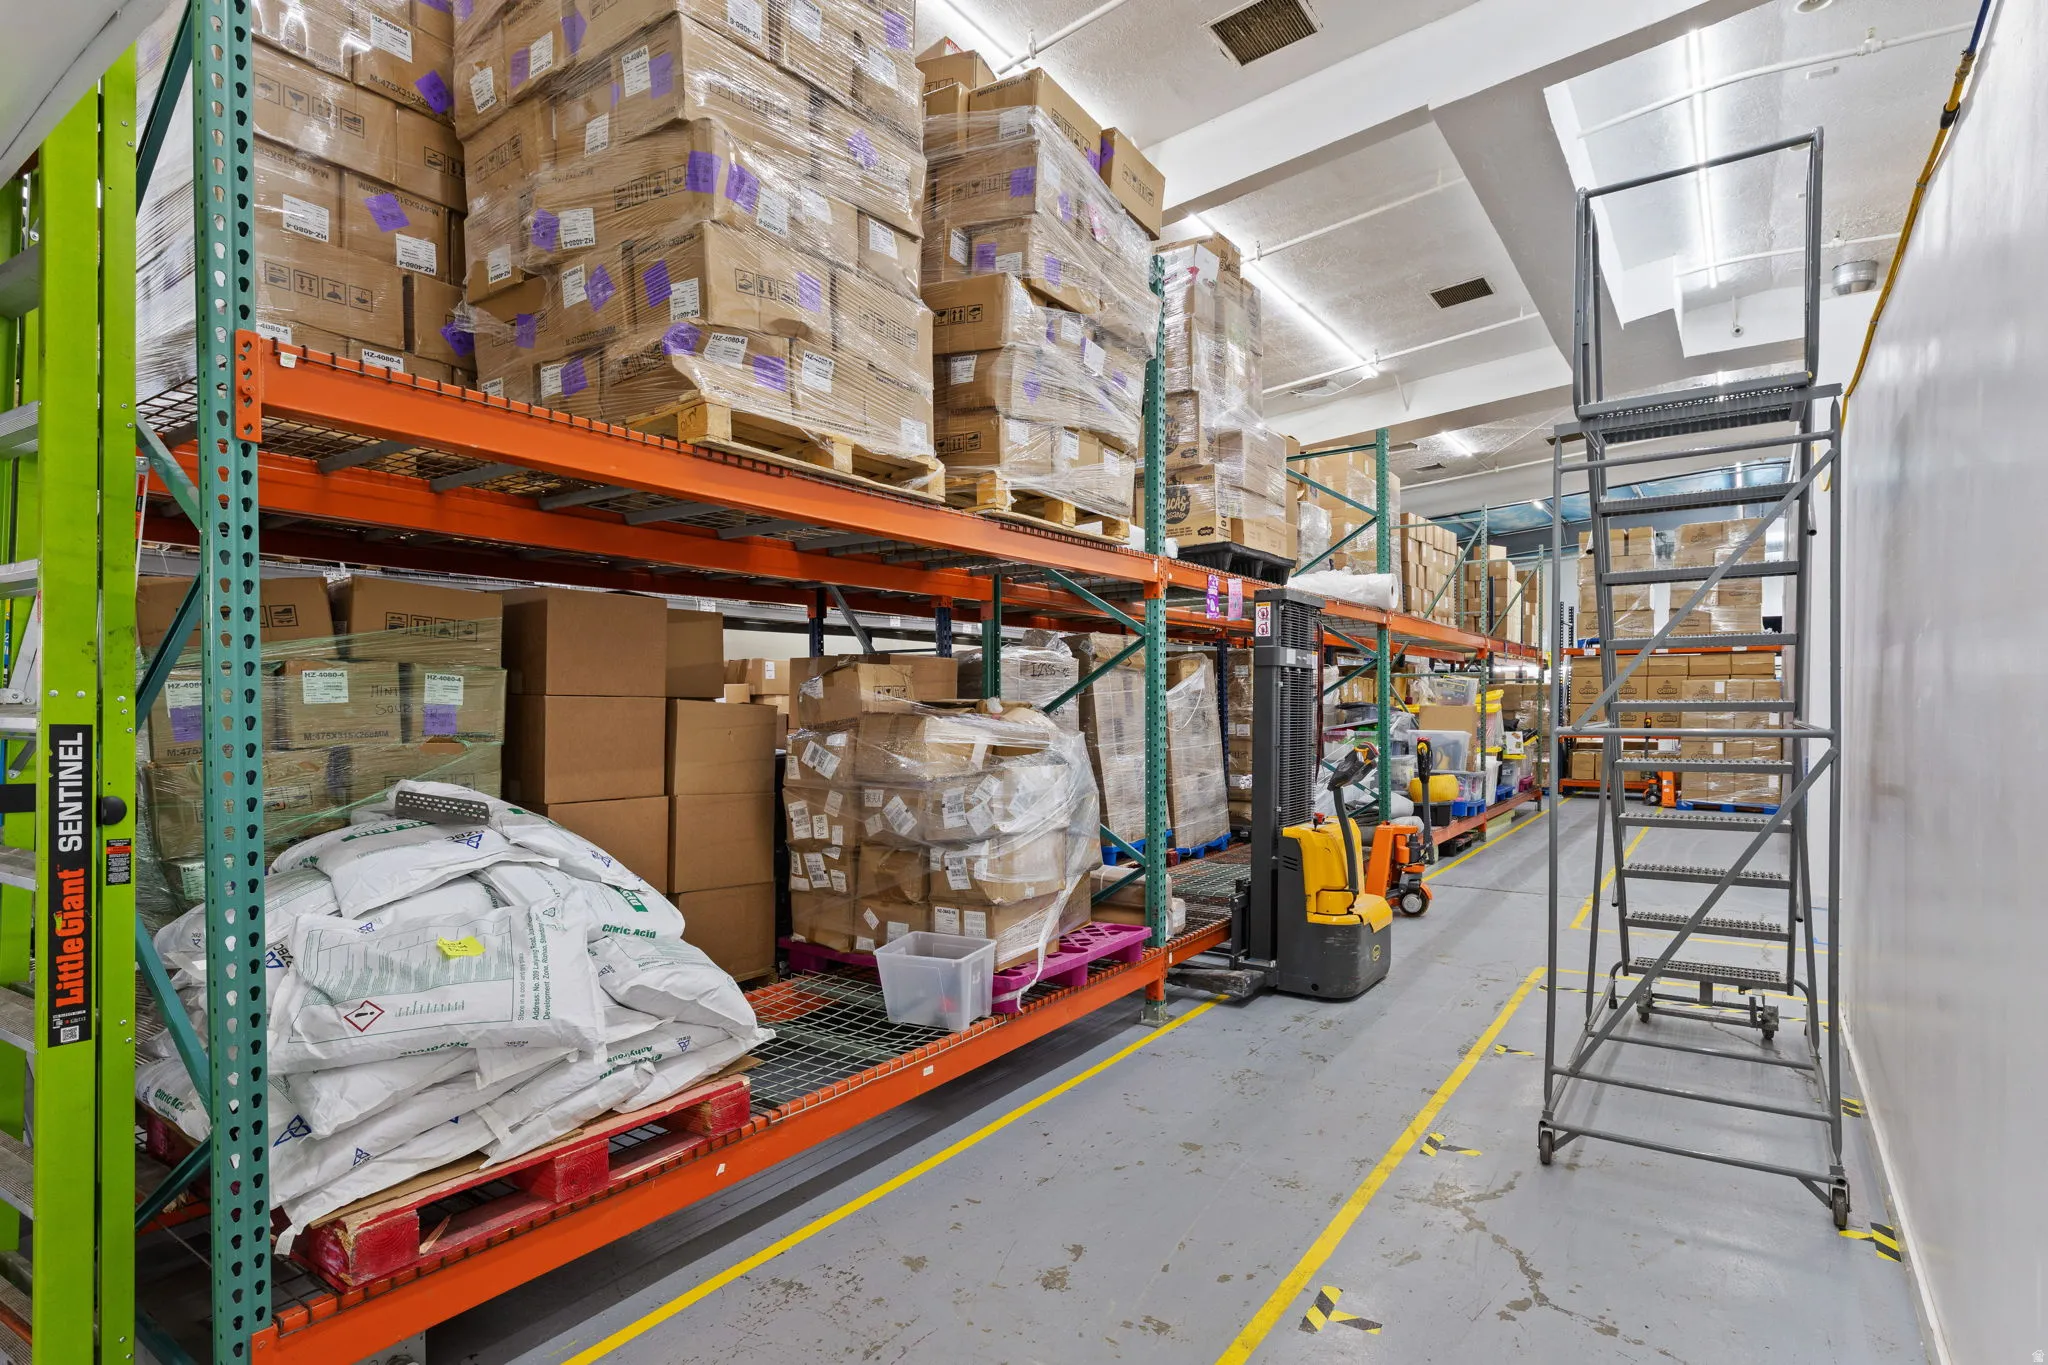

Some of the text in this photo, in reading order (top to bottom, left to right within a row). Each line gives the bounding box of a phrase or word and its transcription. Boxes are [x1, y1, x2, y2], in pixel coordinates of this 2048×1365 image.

[285, 221, 329, 240] HZ-4080-4
[399, 260, 435, 274] HZ-4080-4
[362, 350, 402, 364] HZ-4080-4
[427, 674, 462, 682] HZ-4080-4
[58, 731, 83, 852] SENTINEL
[633, 928, 657, 939] Acid
[543, 981, 552, 1020] Development
